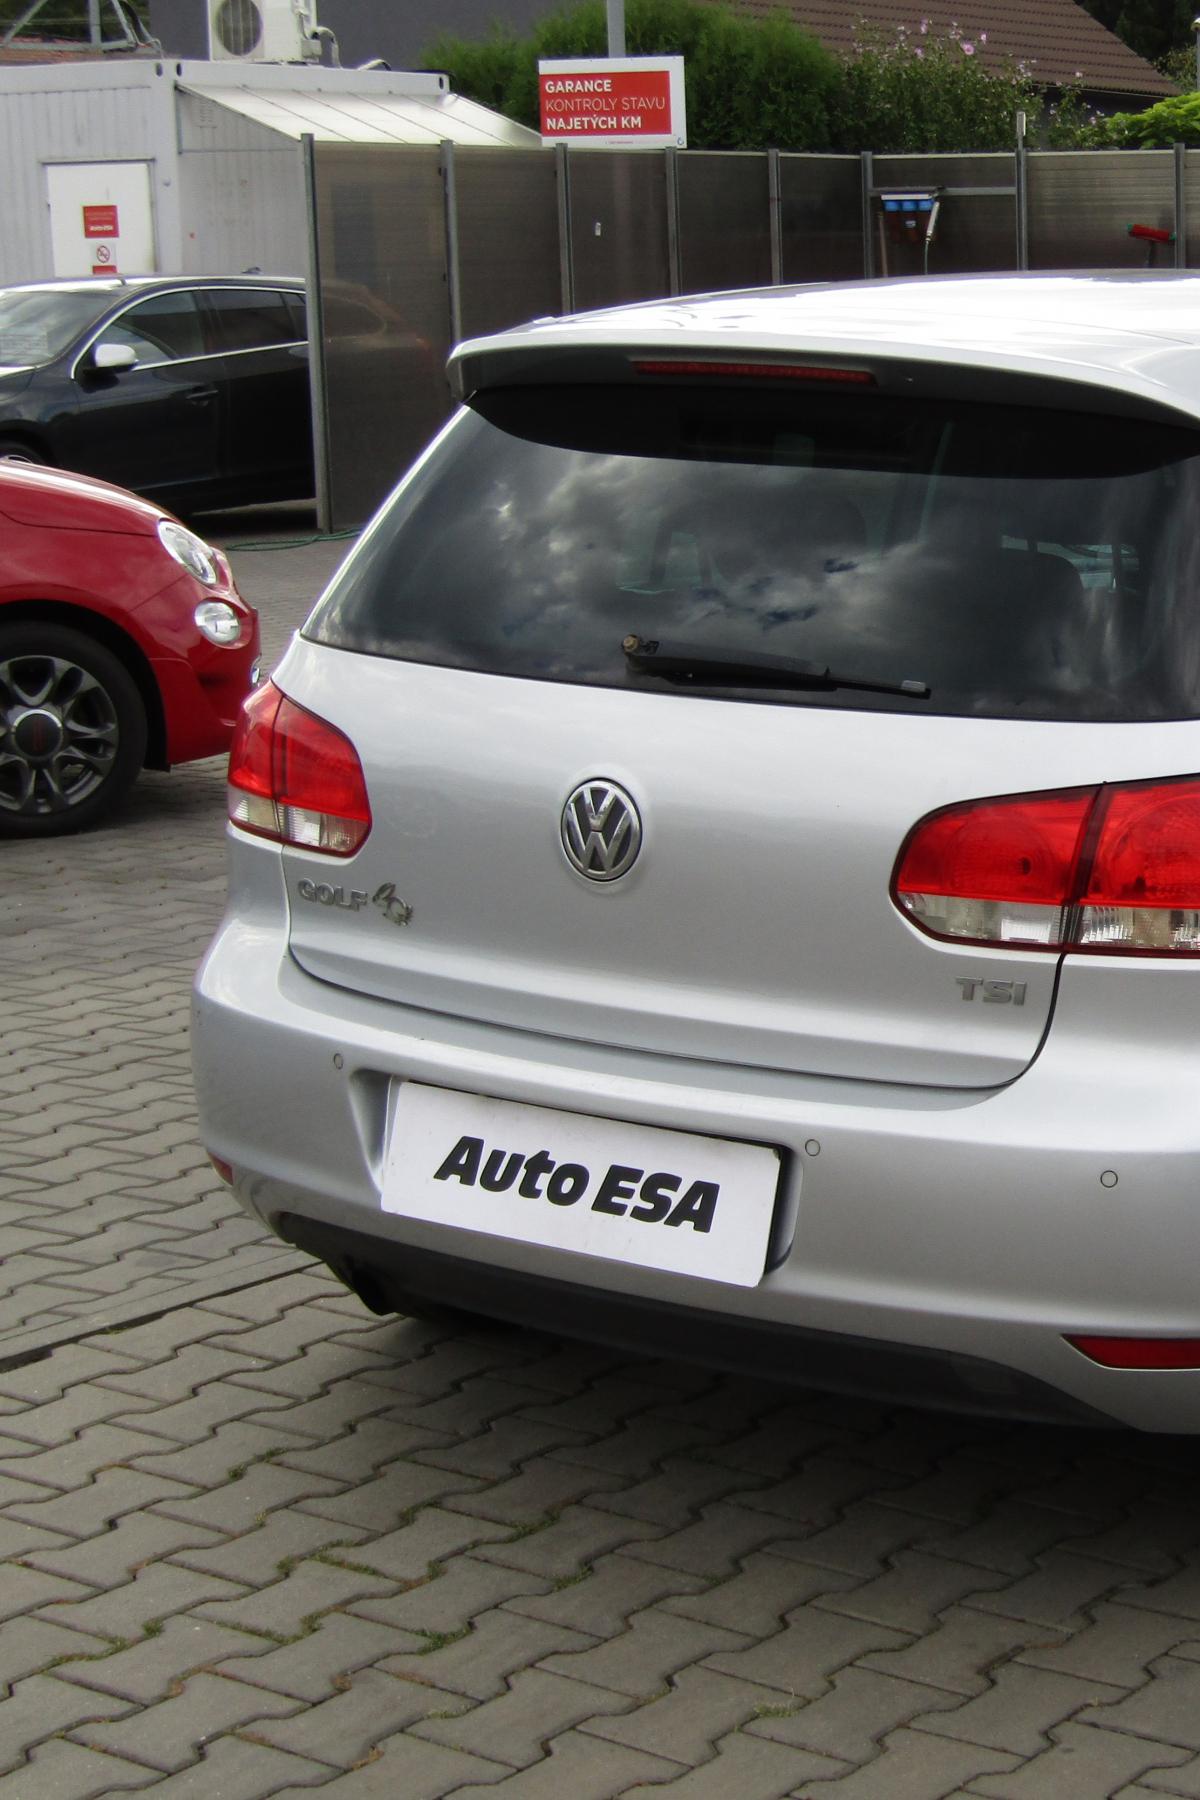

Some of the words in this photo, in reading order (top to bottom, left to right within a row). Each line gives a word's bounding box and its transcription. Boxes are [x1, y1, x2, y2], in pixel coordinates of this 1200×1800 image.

[545, 79, 612, 94] GARANCE
[545, 97, 616, 113] KONTROLY
[621, 96, 666, 111] STAVU
[546, 113, 617, 131] NAJETÝCH
[621, 115, 642, 129] KM
[298, 877, 369, 912] GOLF
[955, 975, 1027, 1006] TSI
[433, 1135, 591, 1206] Auto
[591, 1164, 720, 1233] ESA
